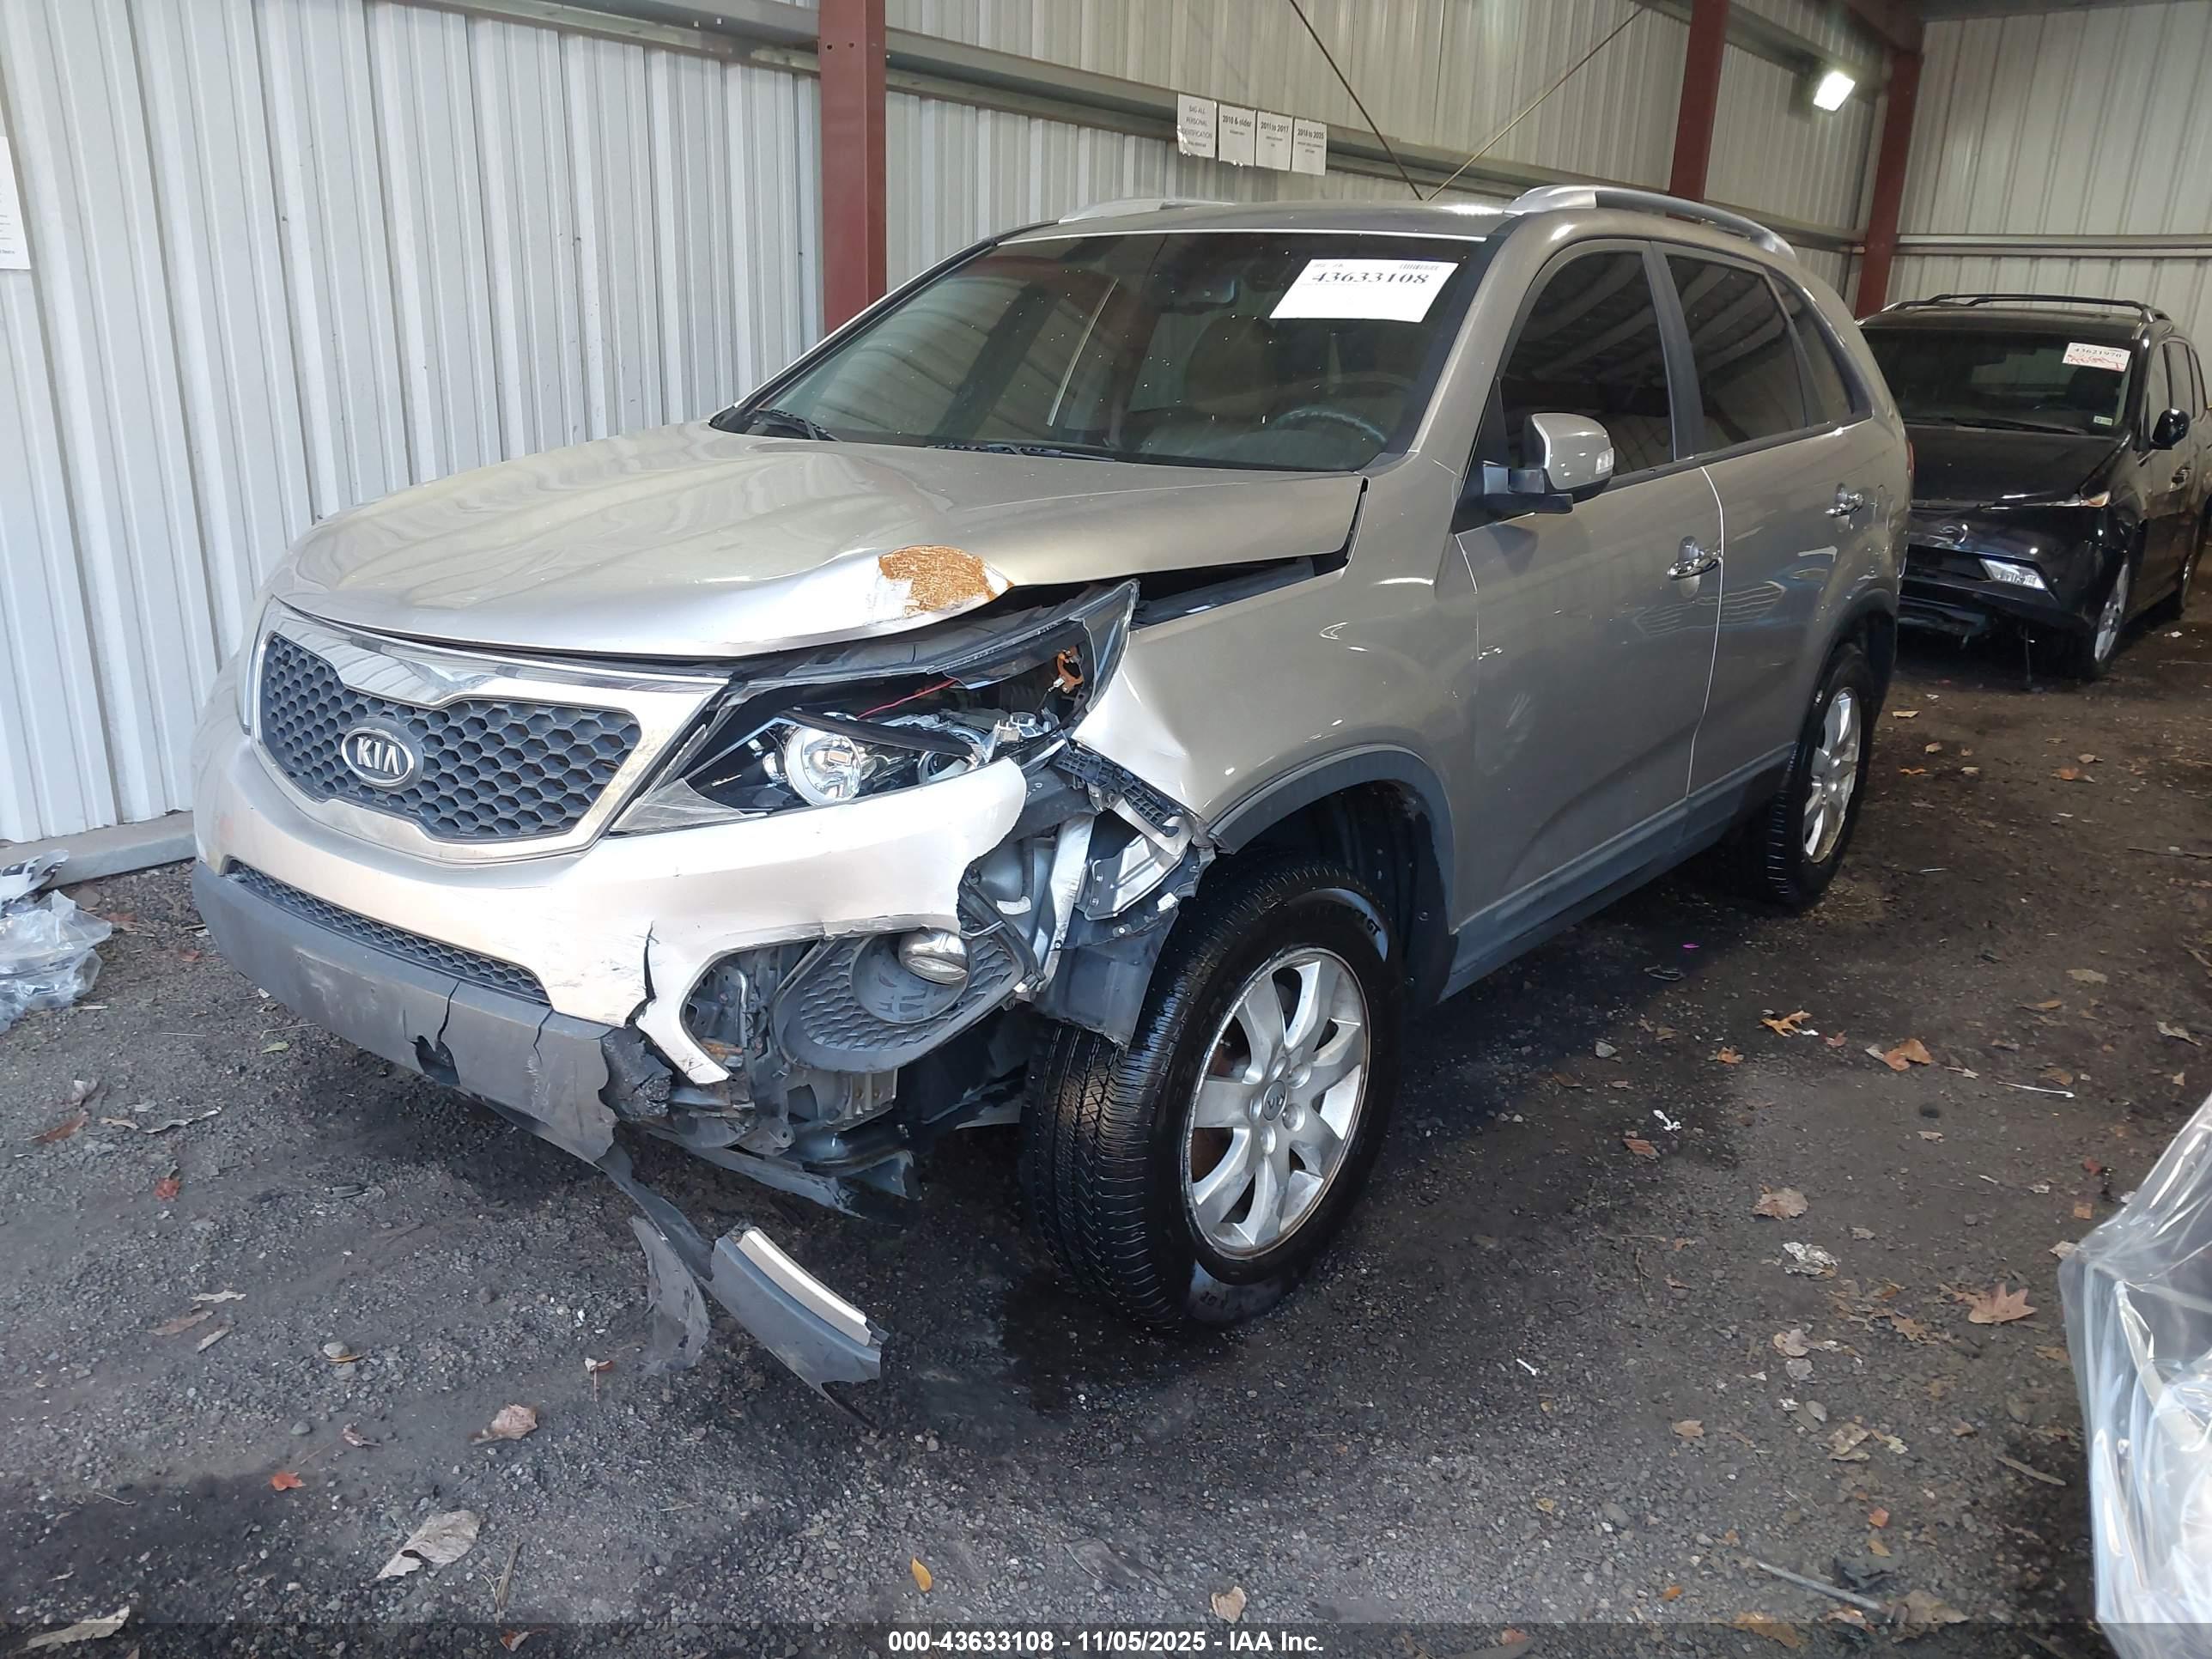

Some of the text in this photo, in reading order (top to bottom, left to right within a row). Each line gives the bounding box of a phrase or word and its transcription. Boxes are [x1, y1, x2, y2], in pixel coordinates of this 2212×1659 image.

[1186, 116, 1208, 126] PERSONAL
[1222, 115, 1233, 125] 2010
[1239, 117, 1252, 127] older
[1261, 121, 1272, 131] 2011
[1277, 123, 1289, 133] 2017
[1312, 271, 1430, 285] 43633108
[357, 736, 400, 775] KIA
